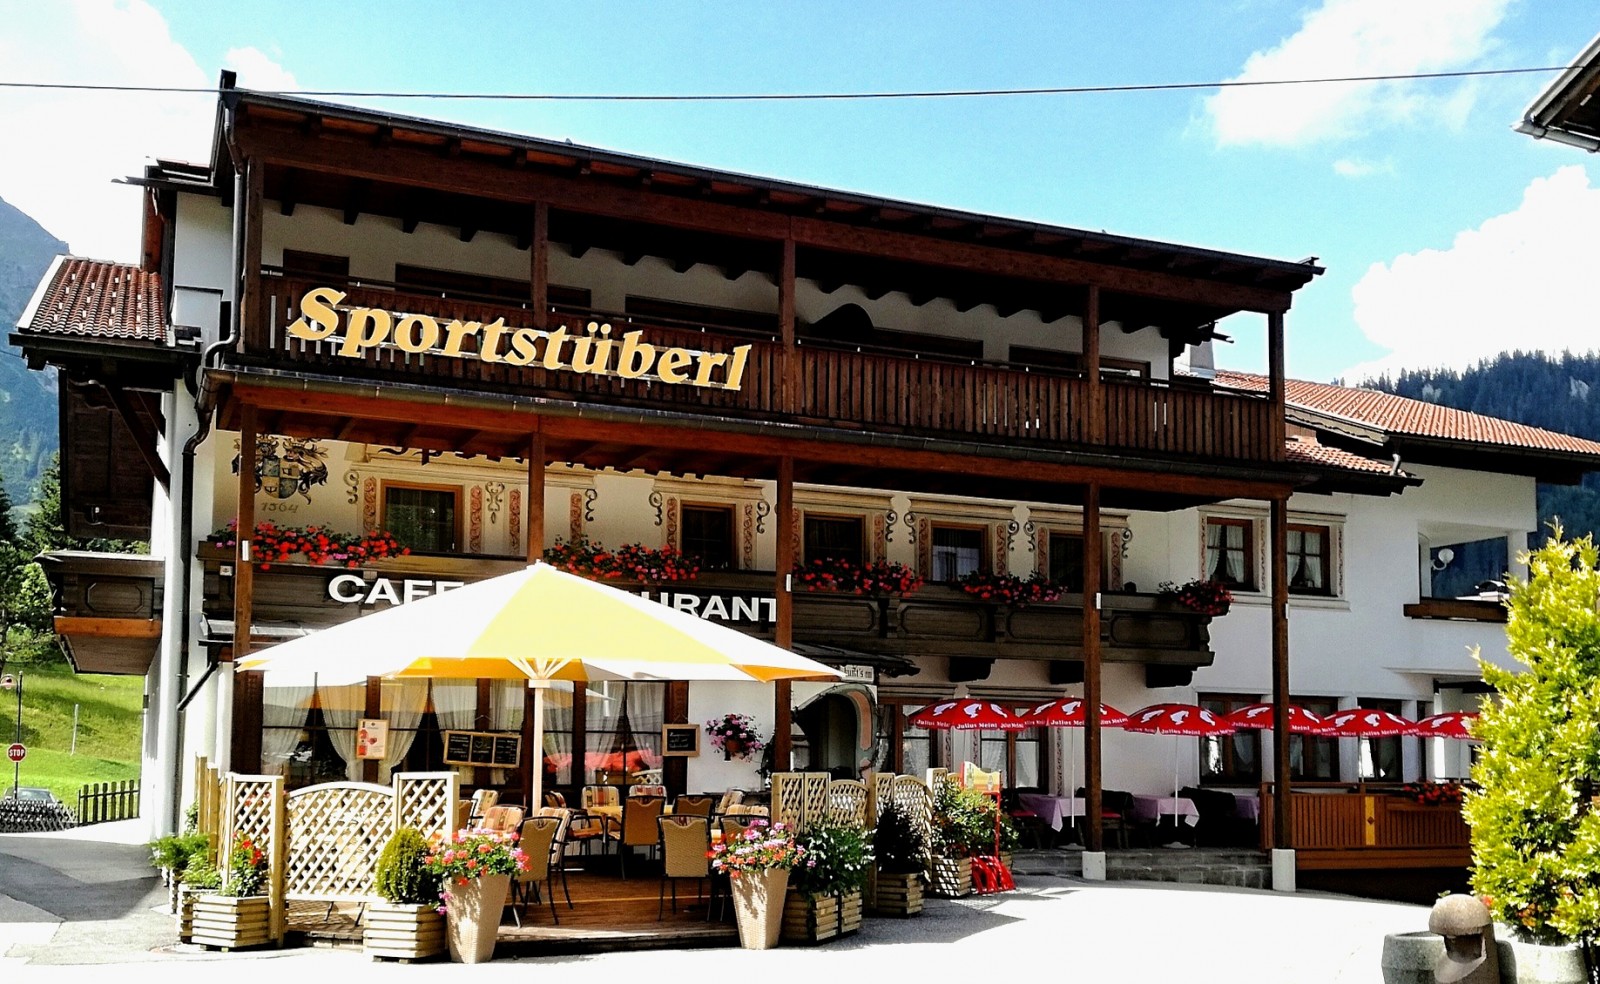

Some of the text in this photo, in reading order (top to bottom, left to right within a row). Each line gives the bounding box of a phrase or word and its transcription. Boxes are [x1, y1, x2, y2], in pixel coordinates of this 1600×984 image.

[287, 287, 752, 391] Sportstüberl
[261, 502, 299, 513] 1564
[9, 749, 25, 757] STOP
